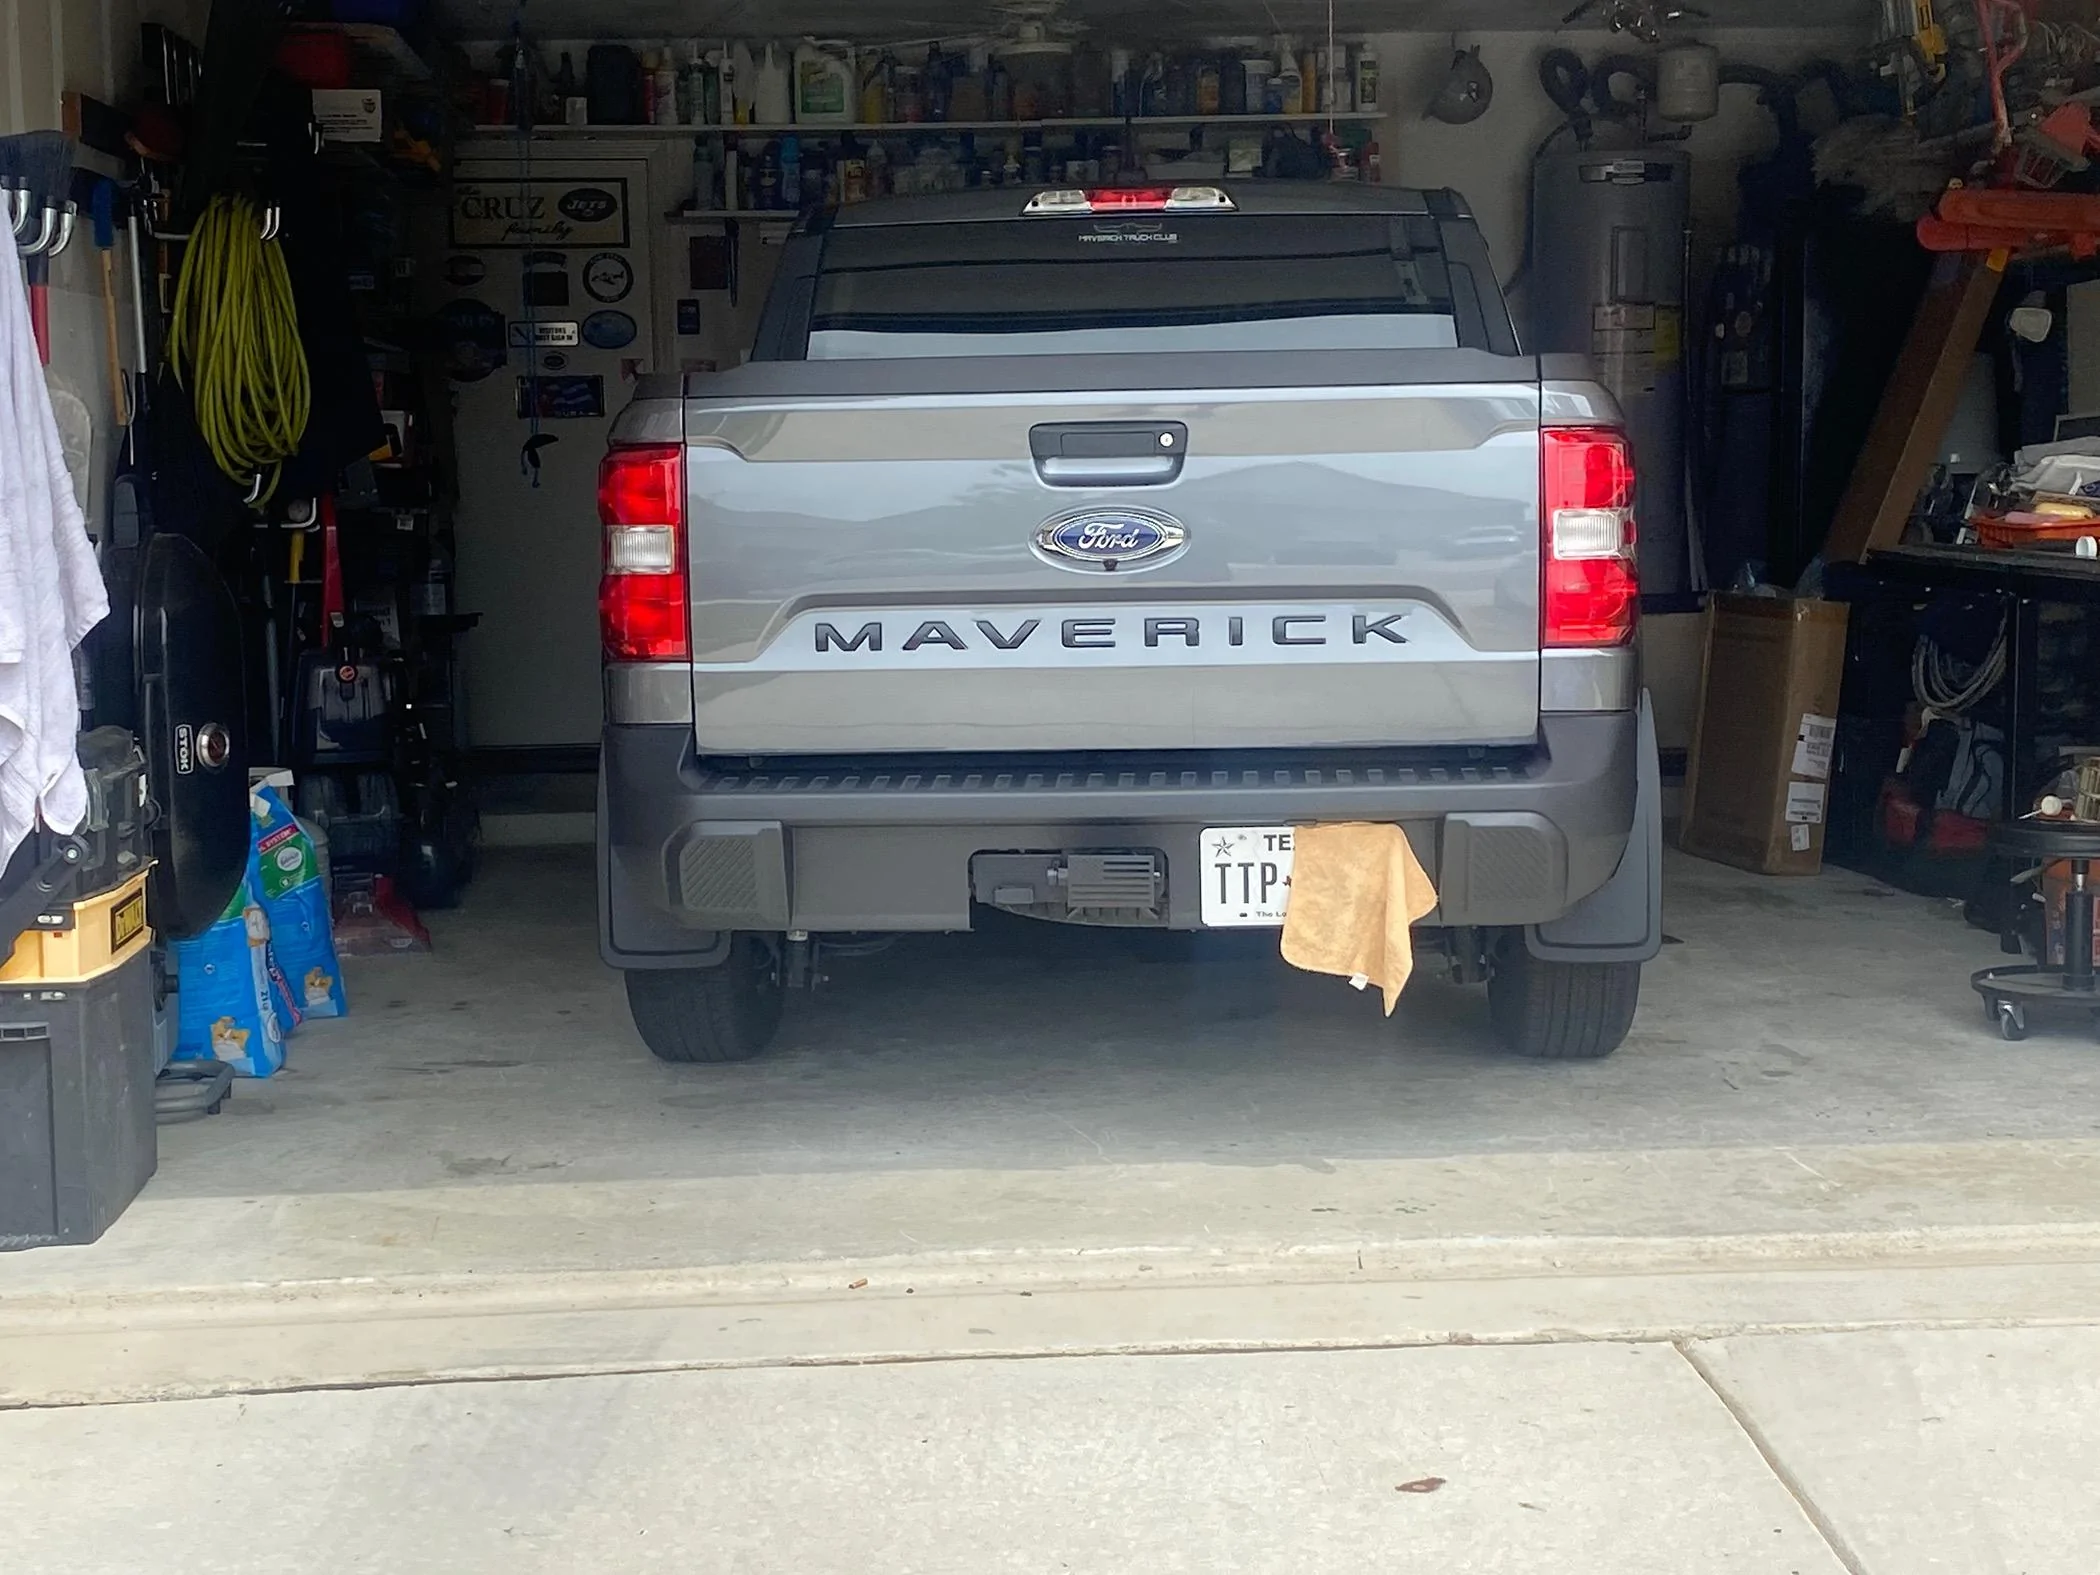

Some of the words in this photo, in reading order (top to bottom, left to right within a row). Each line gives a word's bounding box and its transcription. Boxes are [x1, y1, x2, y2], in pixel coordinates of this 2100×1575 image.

[460, 196, 546, 220] CRUZ
[566, 200, 608, 211] JETS
[501, 220, 573, 241] family
[1153, 233, 1177, 241] CLUB
[1078, 522, 1139, 549] Ford
[815, 614, 1411, 652] MAVERICK
[179, 727, 189, 771] STOK
[1263, 834, 1295, 851] TE
[1214, 862, 1277, 904] TTP
